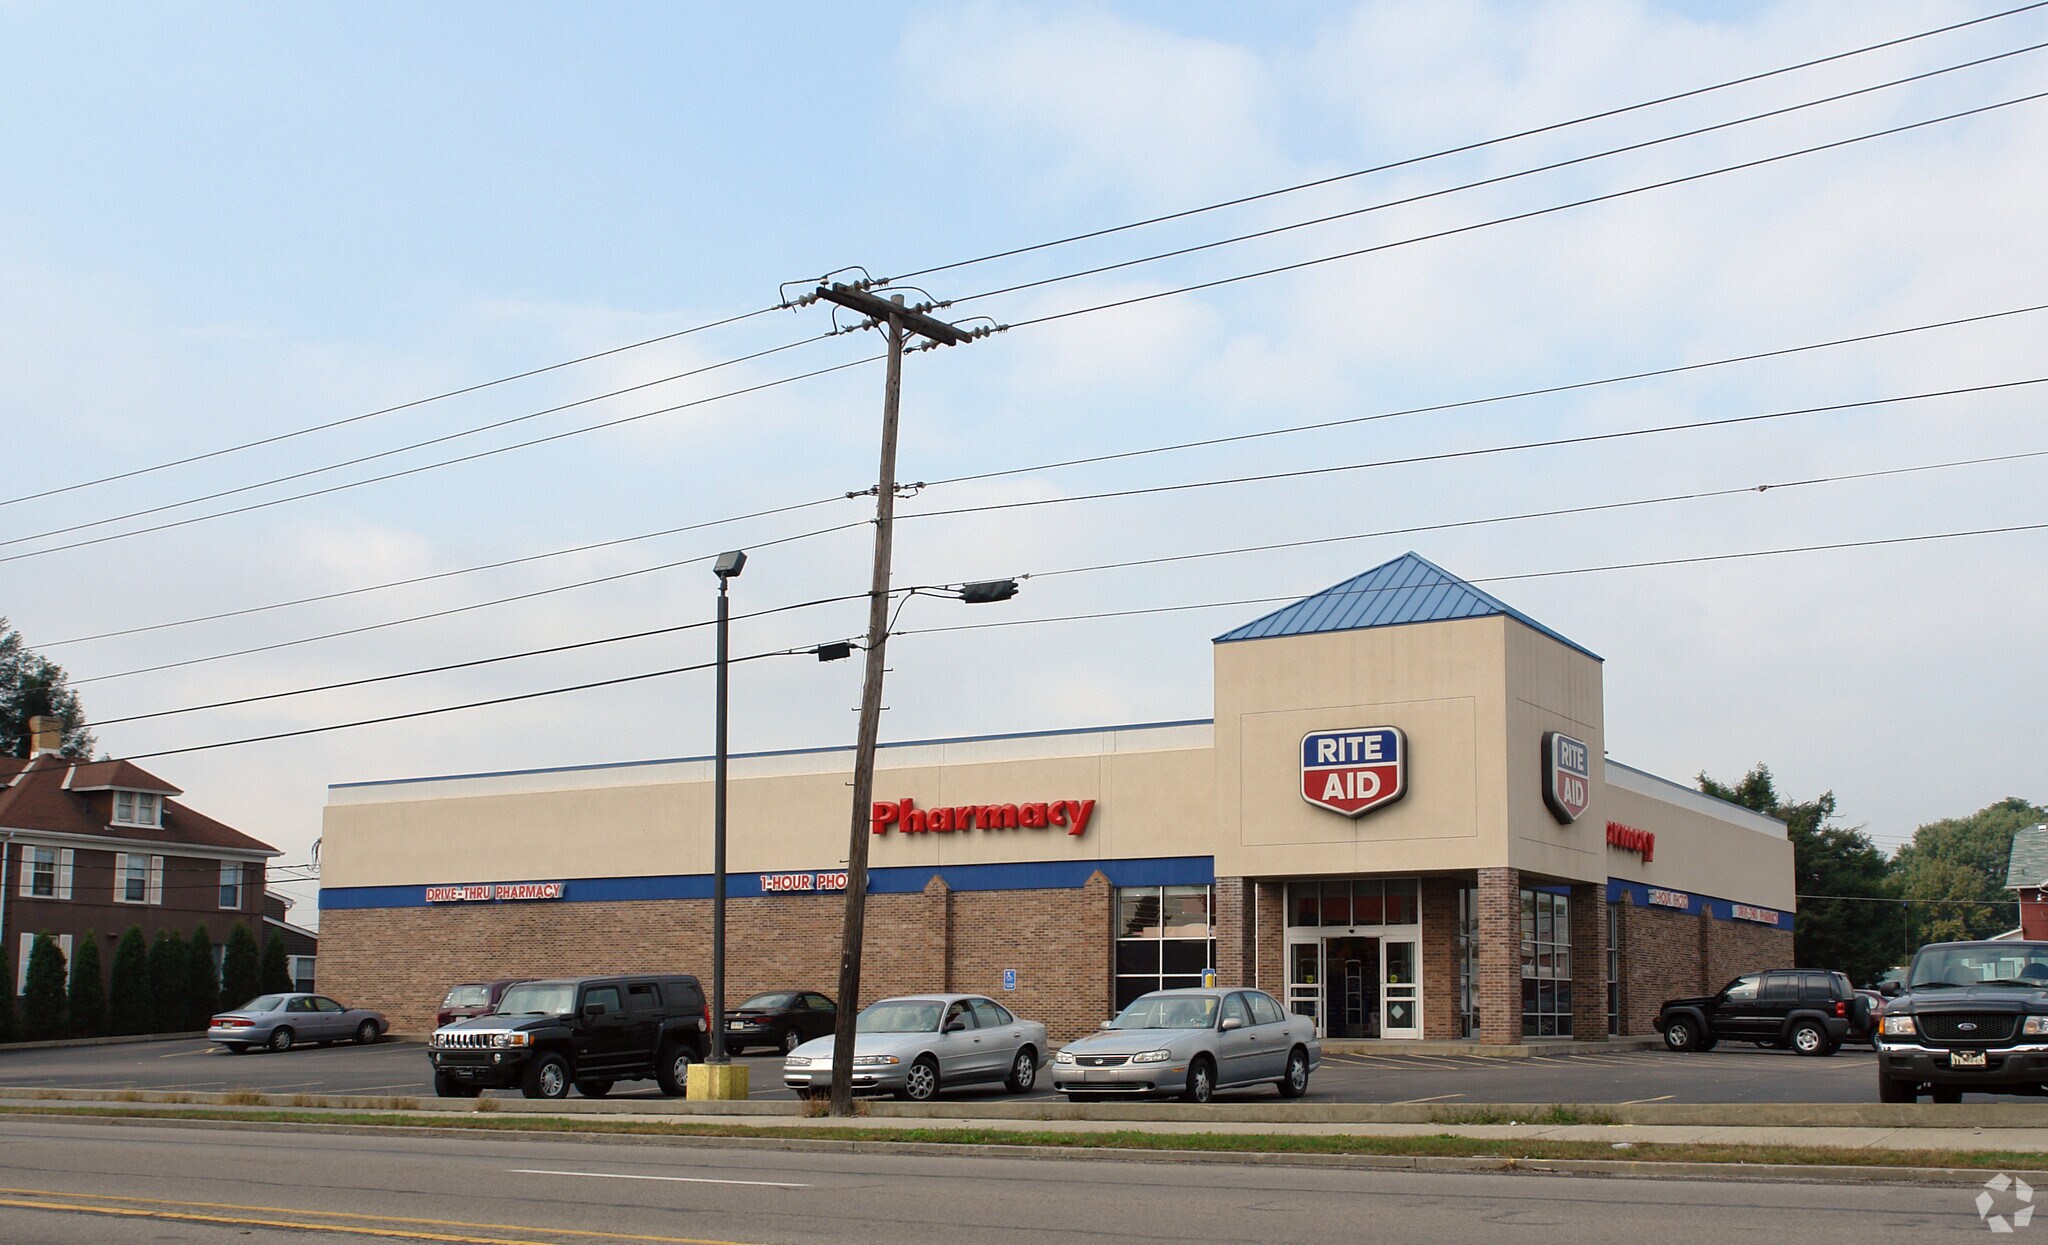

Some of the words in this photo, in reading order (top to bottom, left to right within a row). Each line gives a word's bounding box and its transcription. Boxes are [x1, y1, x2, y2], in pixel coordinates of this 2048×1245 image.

[1317, 734, 1383, 763] RITE
[1561, 742, 1584, 771] RITE
[1321, 770, 1381, 801] AID
[1563, 777, 1584, 807] AID
[872, 797, 1097, 836] Pharmacy
[1606, 820, 1656, 863] armacy
[426, 885, 491, 902] DRIVE-THRU
[495, 883, 562, 899] PHARMACY
[761, 874, 811, 891] 1-HOUR
[817, 872, 848, 890] PHO
